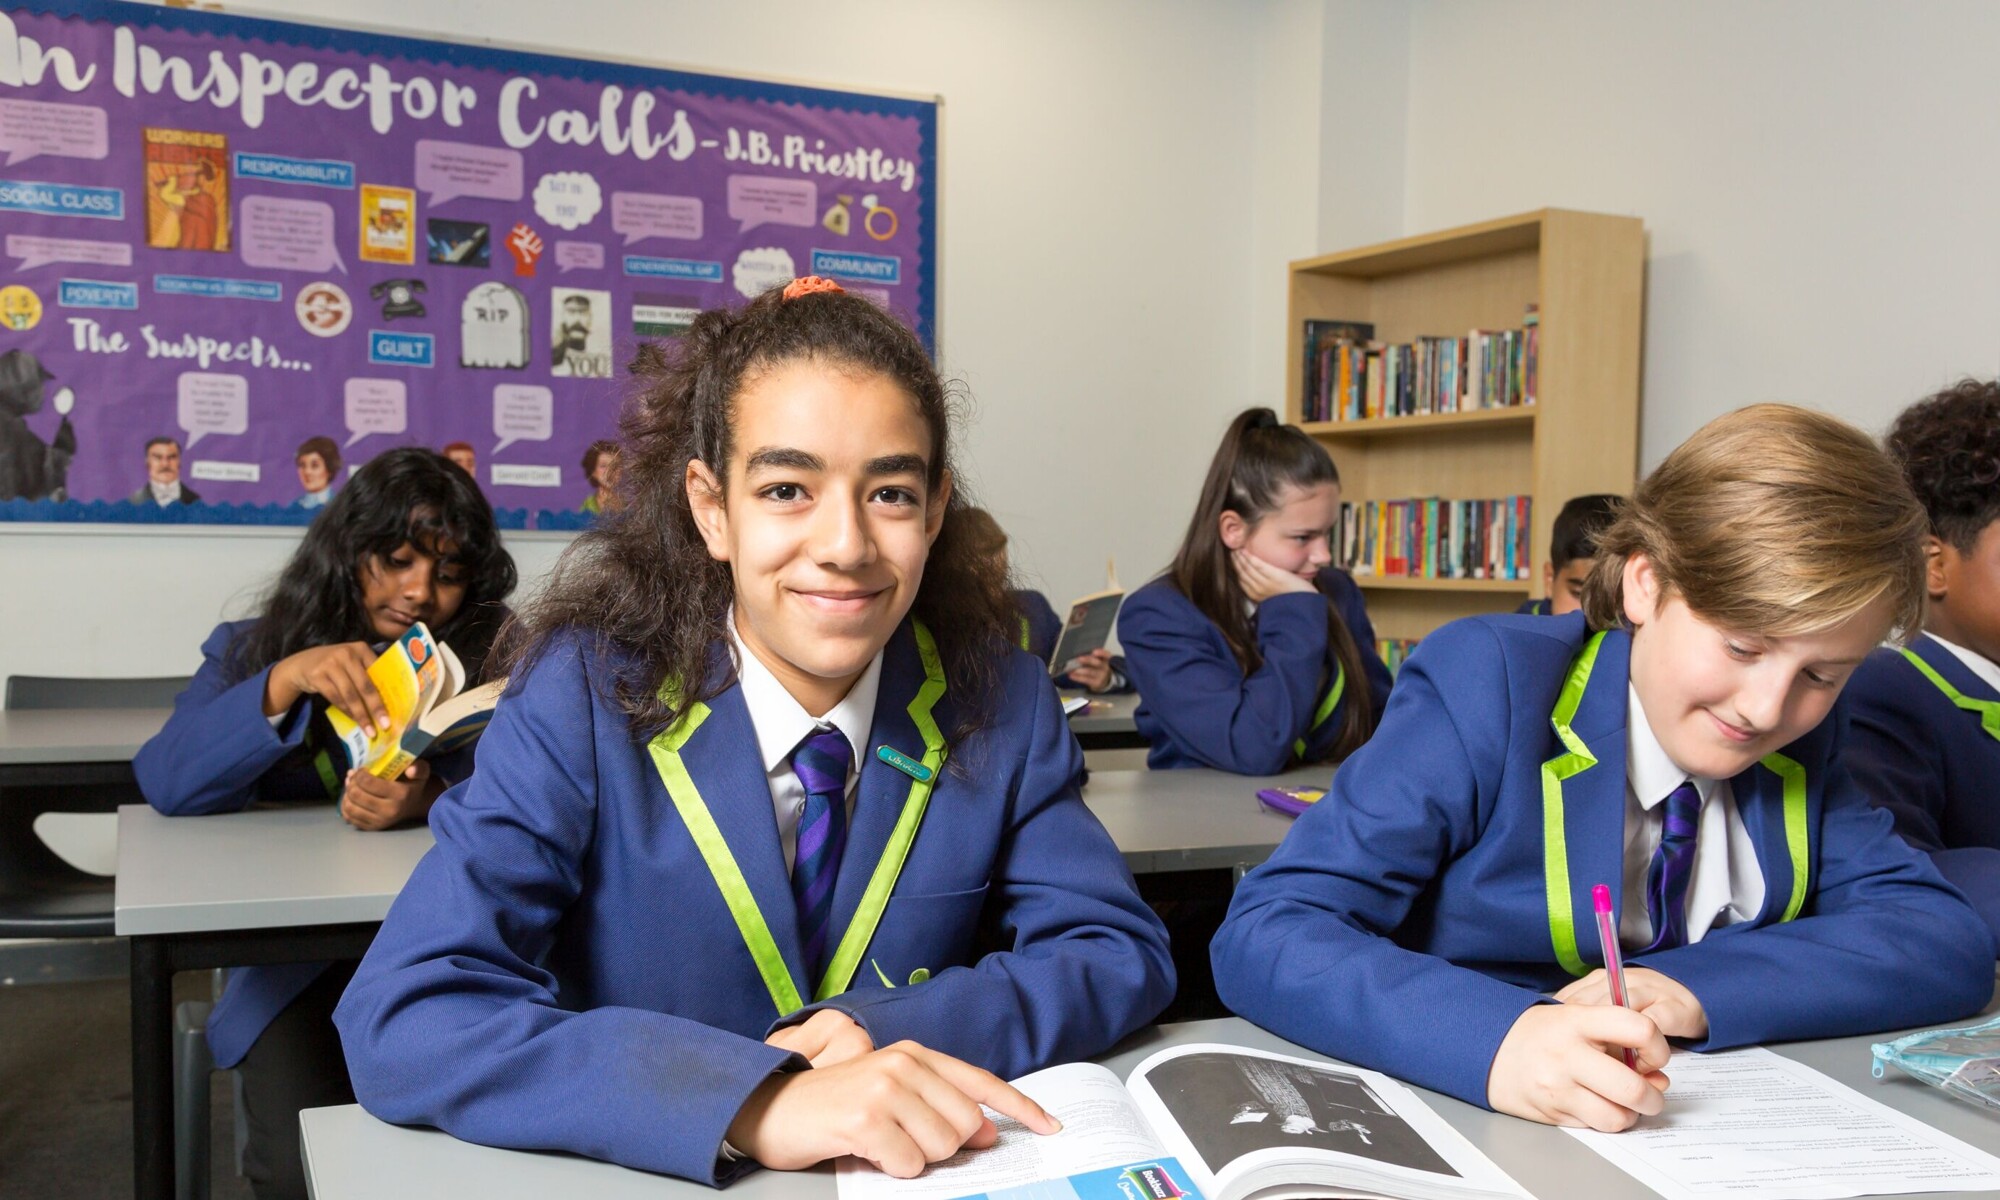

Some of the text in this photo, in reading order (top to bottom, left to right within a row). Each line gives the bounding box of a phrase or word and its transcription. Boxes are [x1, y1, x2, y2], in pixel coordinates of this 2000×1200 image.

[113, 26, 478, 134] Inspector
[499, 77, 696, 160] Calls
[145, 128, 225, 149] WORKERS
[240, 158, 348, 182] RESPONSIBILITY
[0, 187, 115, 211] SOCIAL CLASS
[817, 257, 894, 276] COMMUNITY
[66, 285, 133, 303] POVERTY
[475, 307, 510, 322] RIP
[67, 317, 312, 371] The Suspects...
[377, 340, 425, 359] GUILT
[566, 354, 607, 377] YOU
[1142, 1169, 1167, 1198] Bookbuzz
